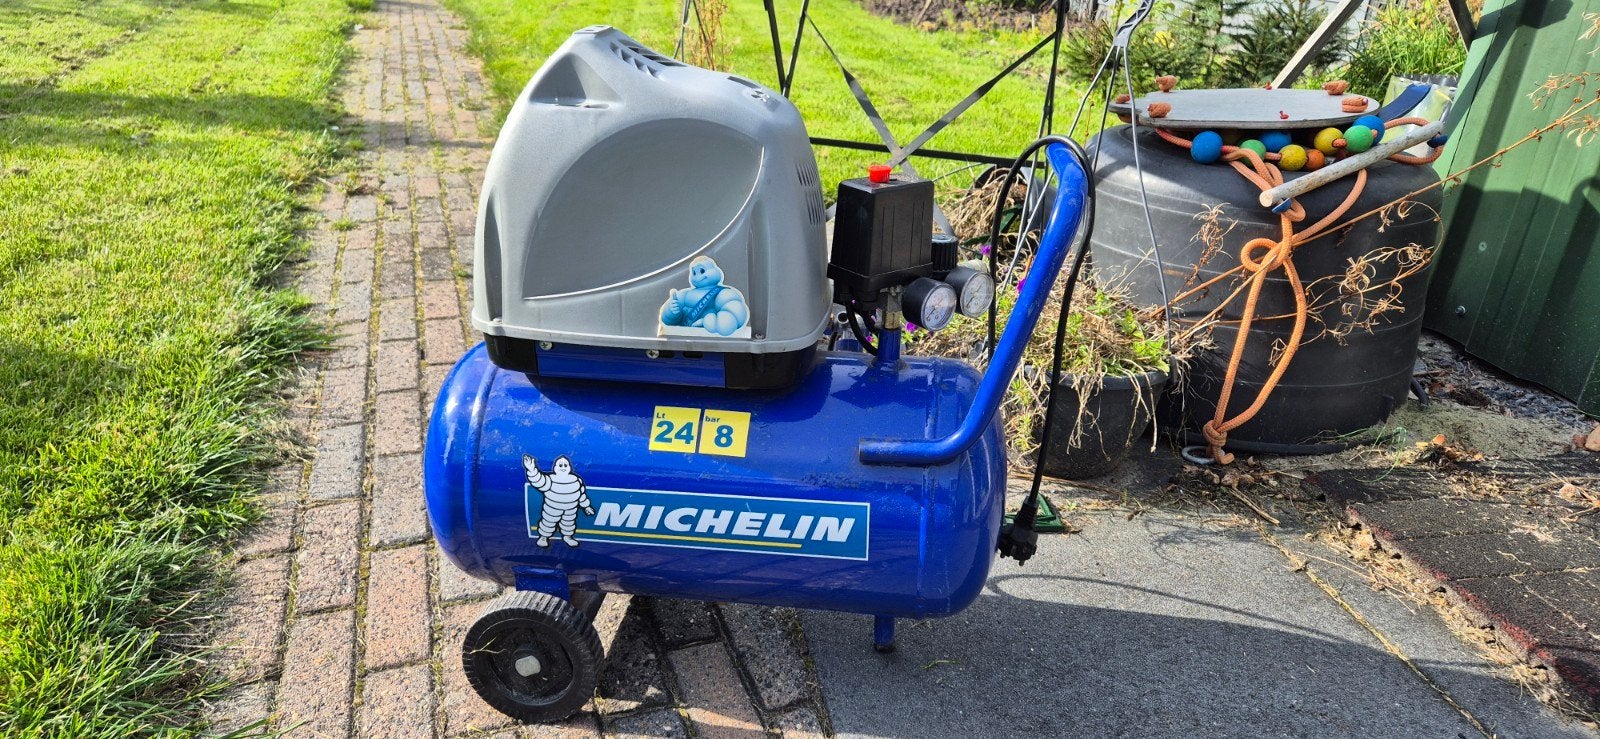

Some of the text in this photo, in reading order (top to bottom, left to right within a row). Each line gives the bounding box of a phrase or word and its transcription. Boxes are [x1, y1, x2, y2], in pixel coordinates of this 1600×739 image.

[704, 415, 721, 423] bar
[654, 420, 694, 445] 24
[714, 424, 734, 448] 8
[593, 502, 856, 543] MICHELIN
